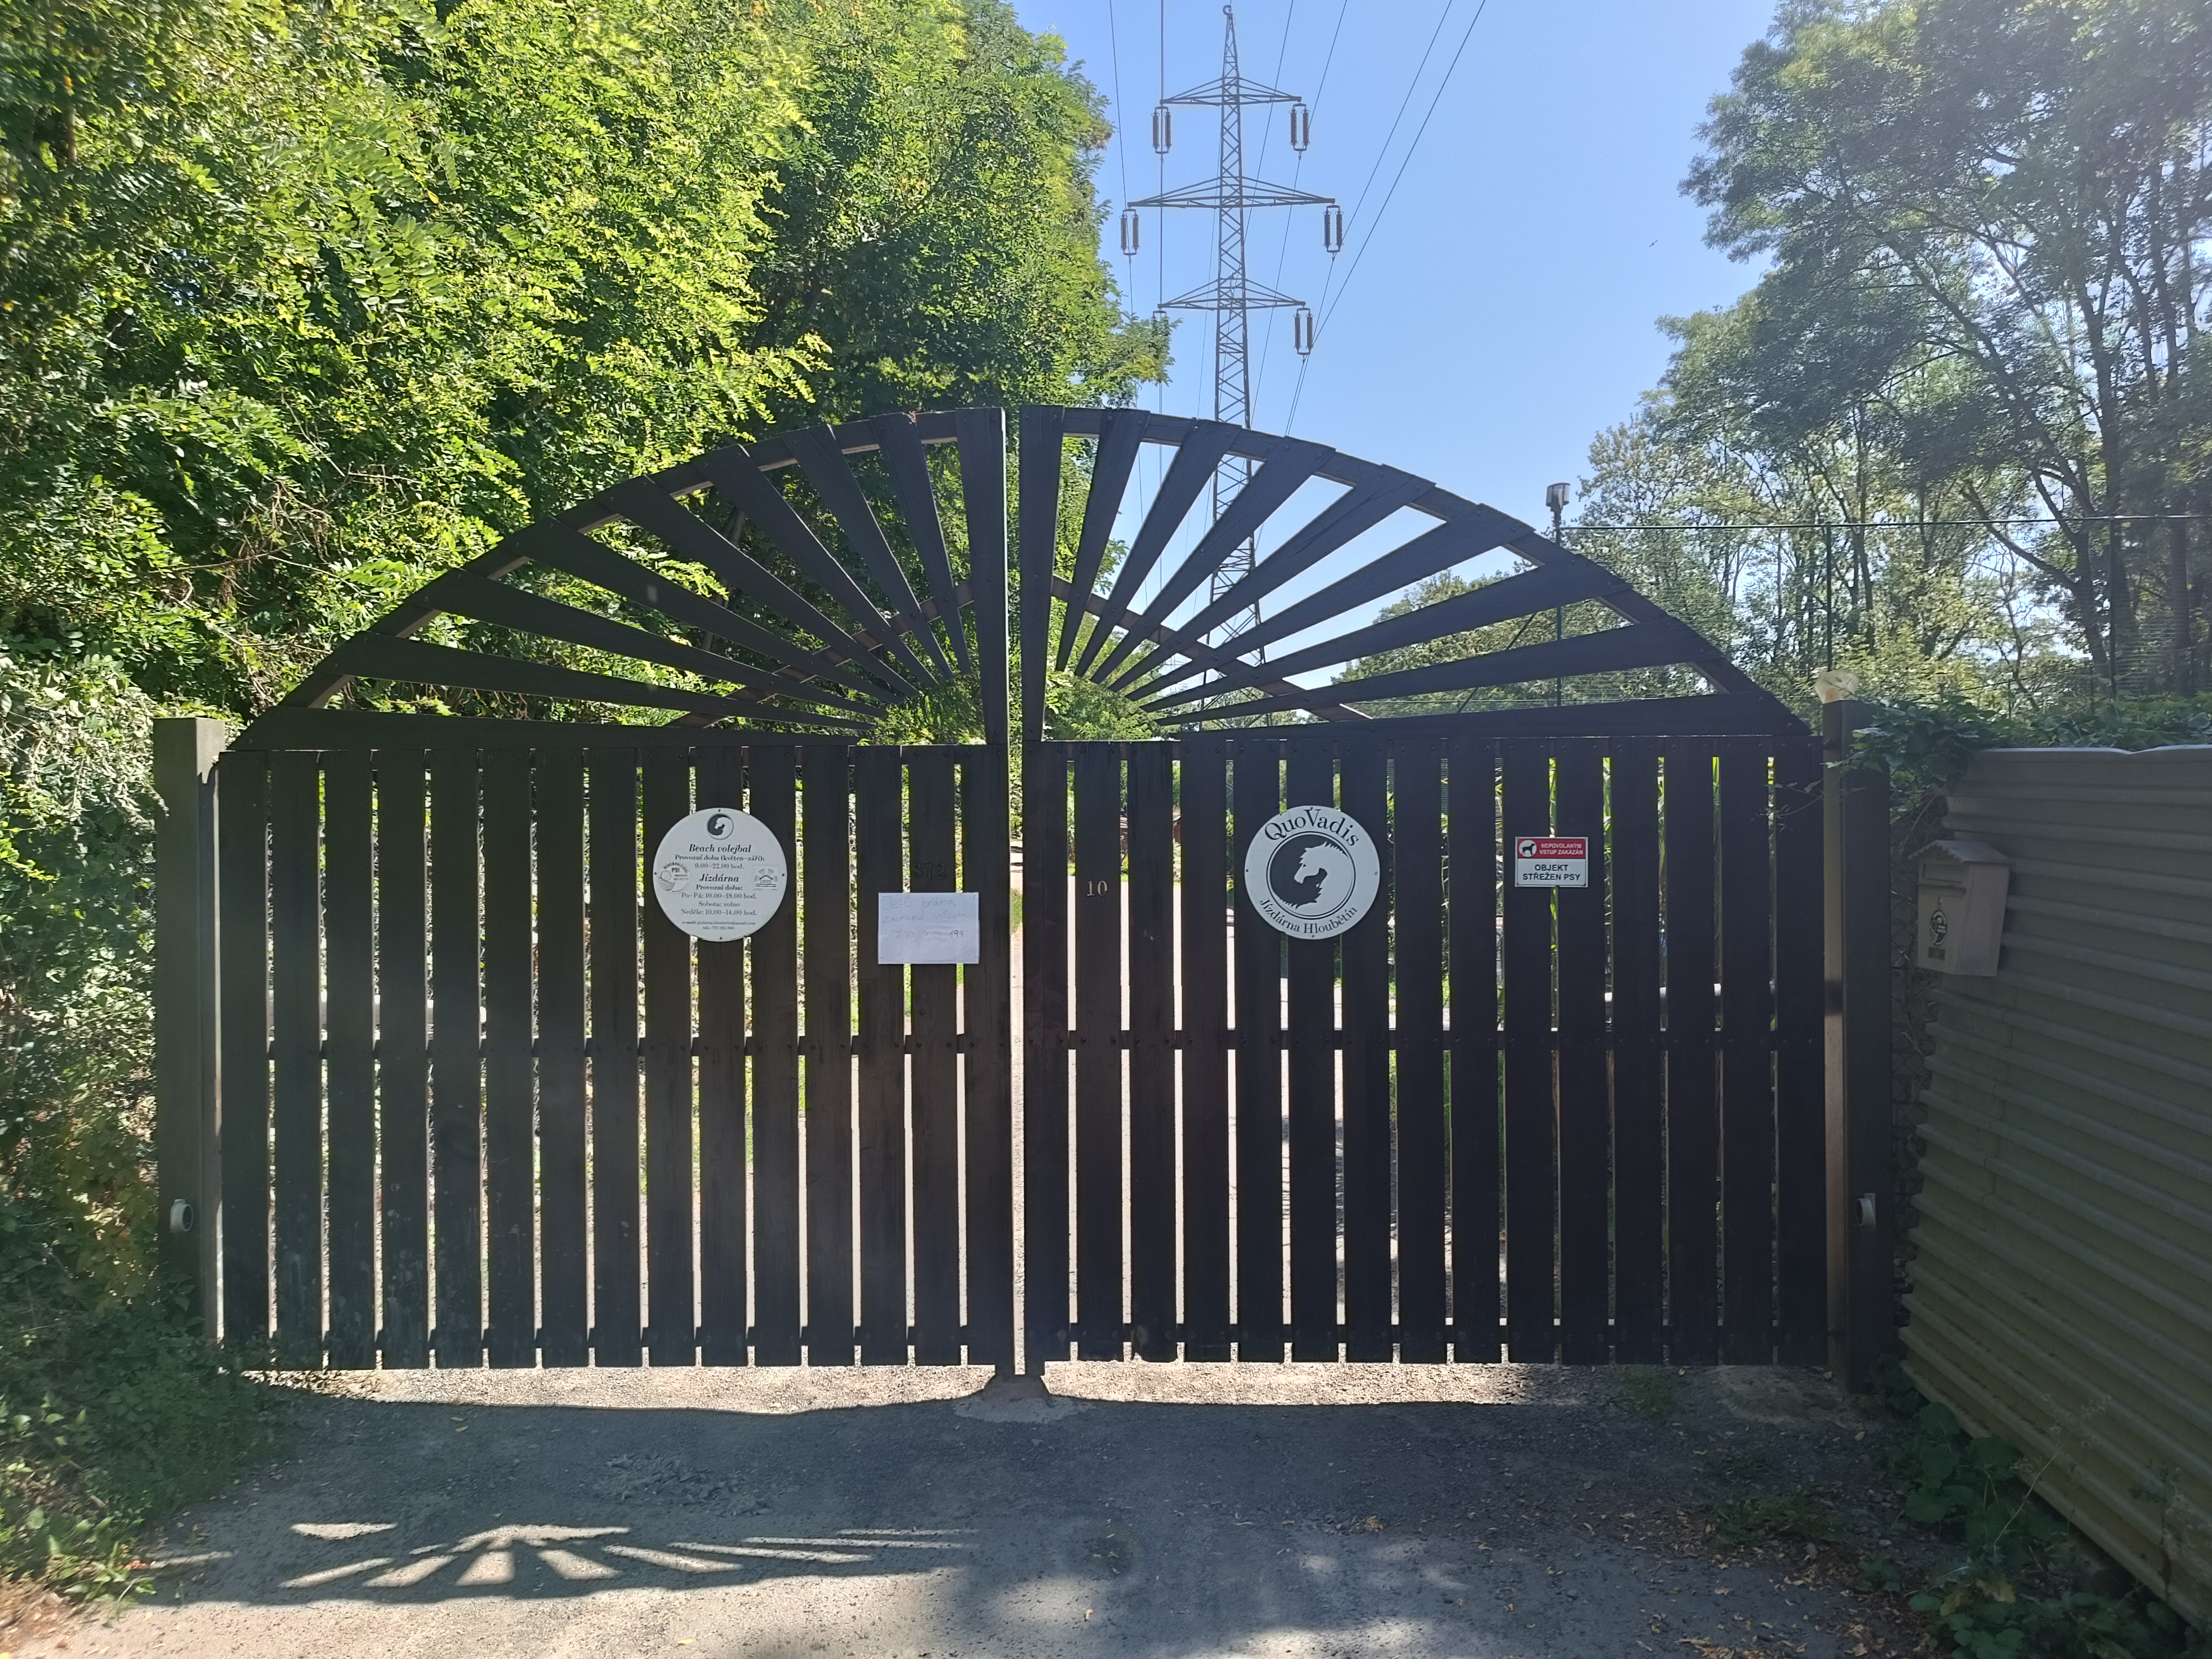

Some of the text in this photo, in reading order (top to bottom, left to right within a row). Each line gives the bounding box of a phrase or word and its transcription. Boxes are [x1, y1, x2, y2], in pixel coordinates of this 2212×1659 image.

[689, 844, 752, 854] Beach volejbal
[699, 874, 739, 882] Jízdárna
[1522, 872, 1561, 880] STŘEŽEN
[1086, 880, 1108, 896] 10
[1260, 898, 1358, 934] Jízdárna Hloubětín
